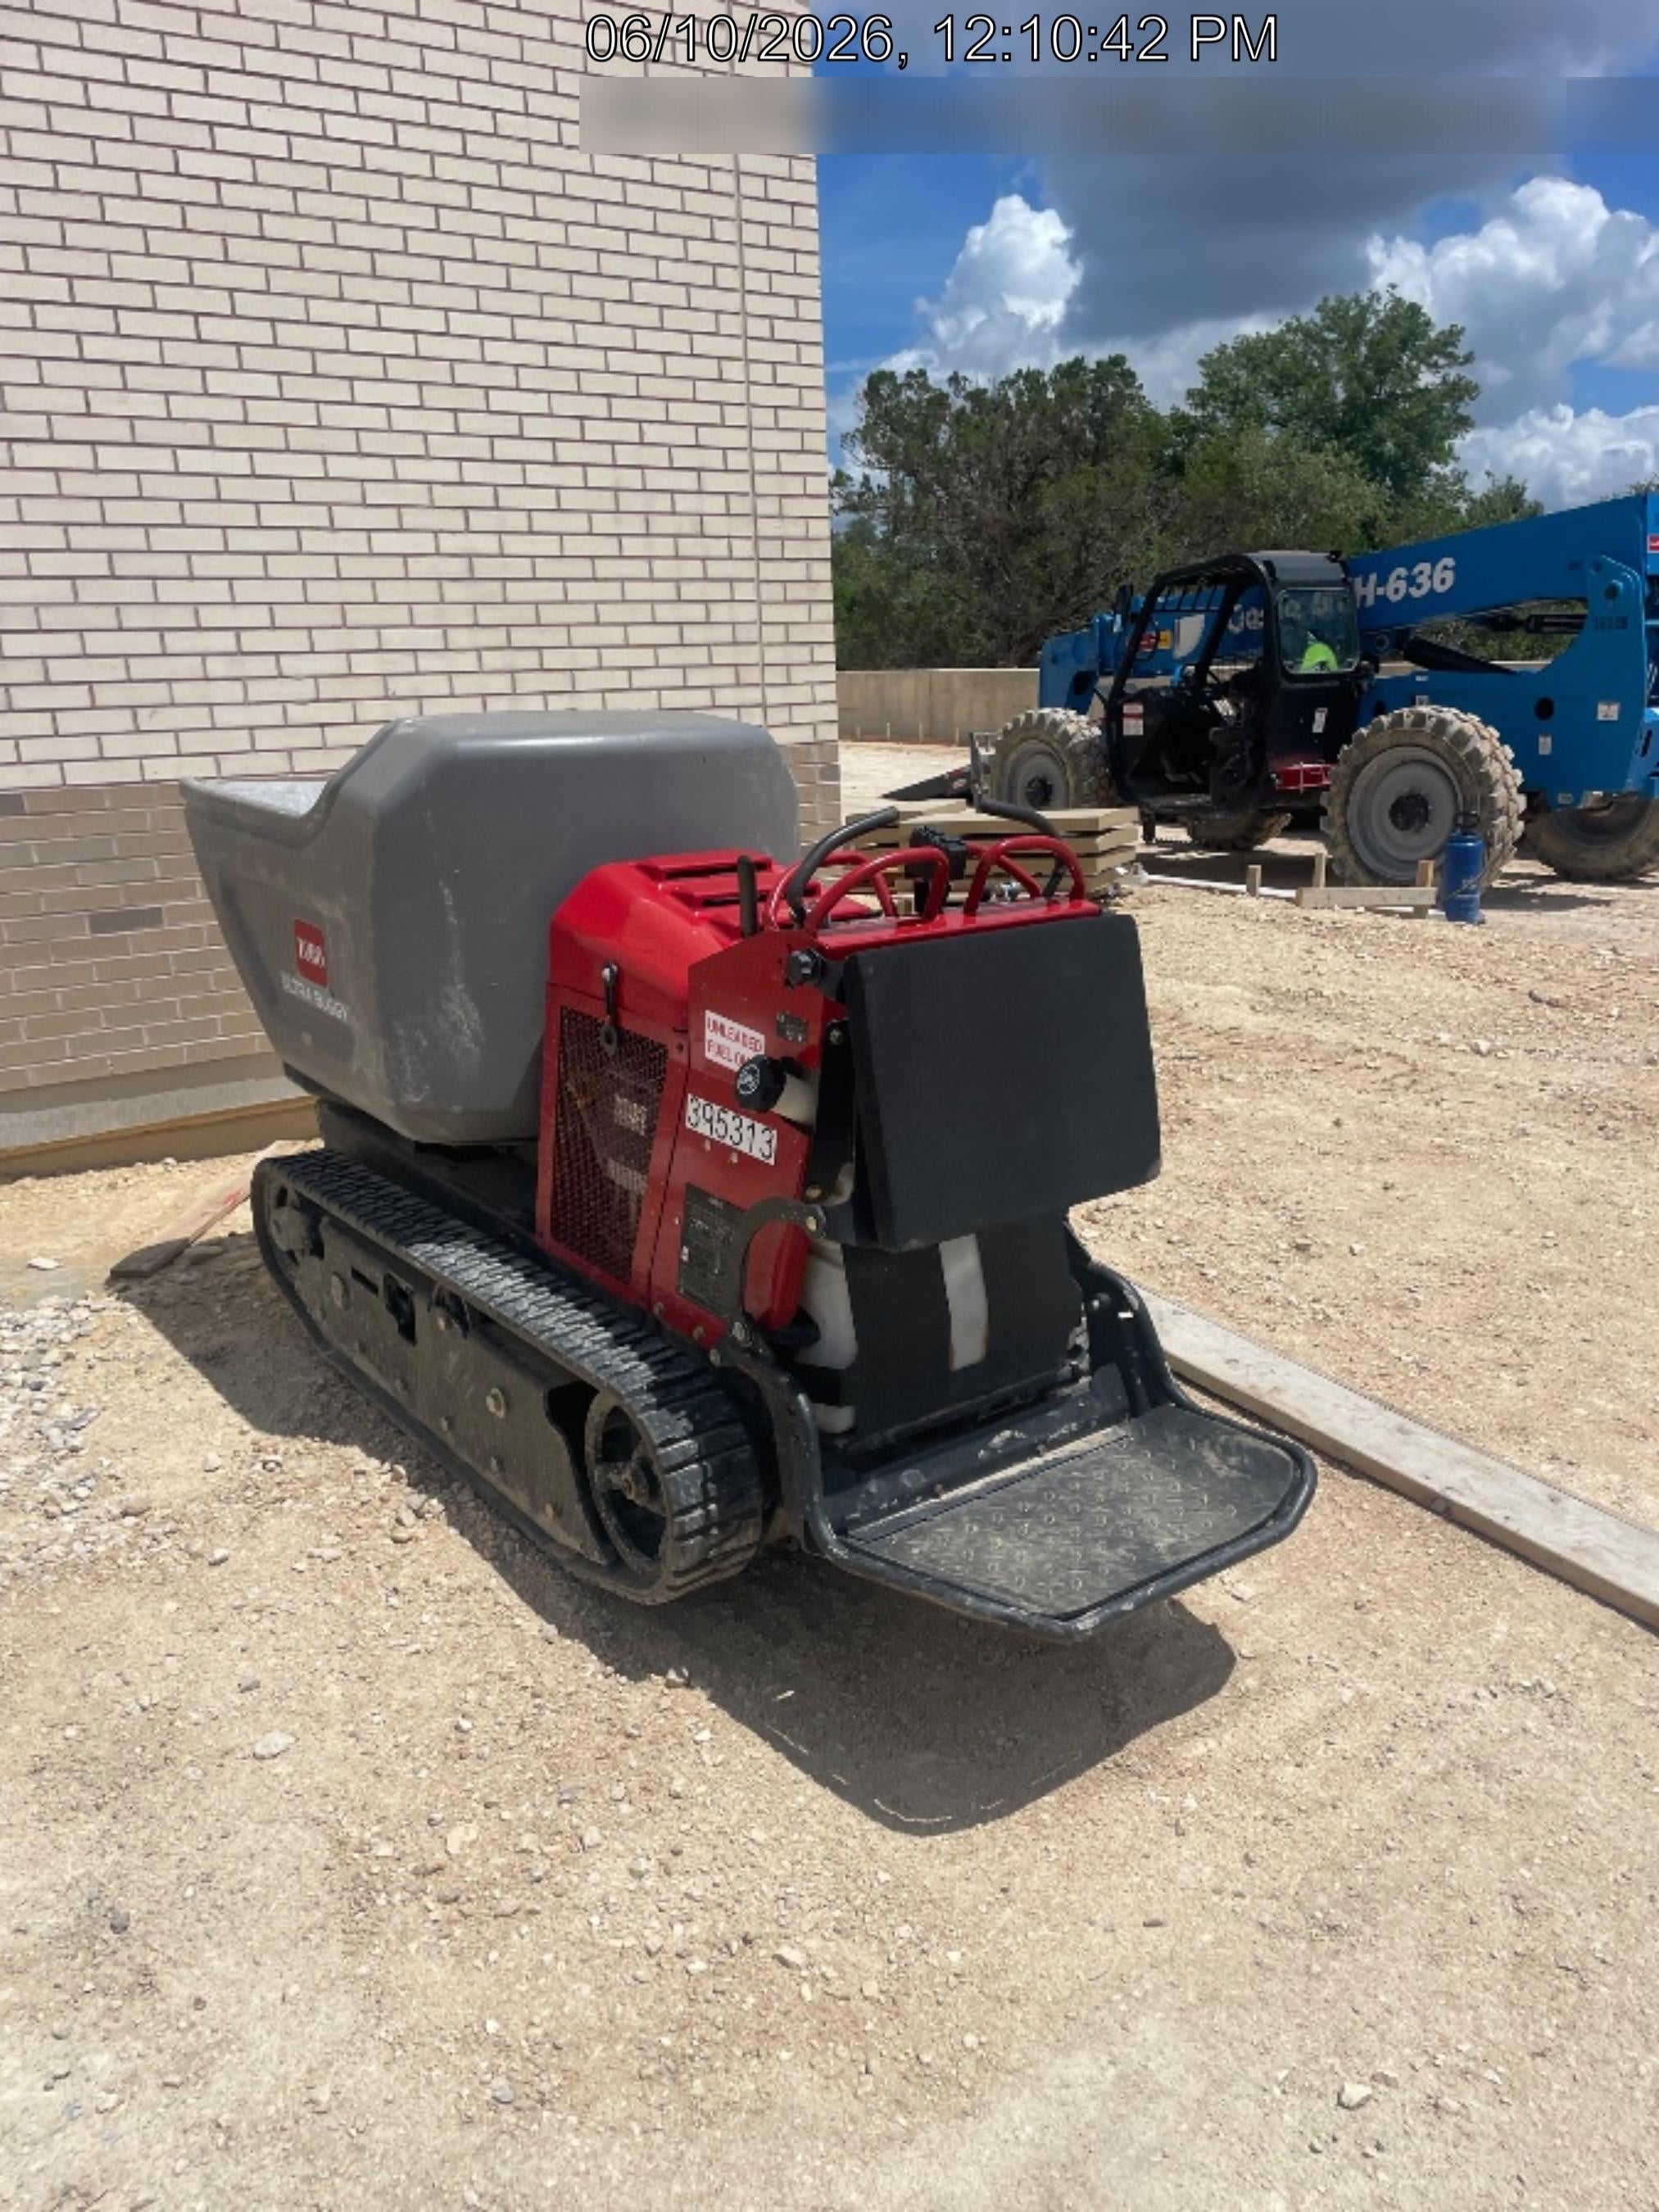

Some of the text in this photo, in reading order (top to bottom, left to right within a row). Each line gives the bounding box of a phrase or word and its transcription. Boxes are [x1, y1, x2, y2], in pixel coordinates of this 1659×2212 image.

[707, 1017, 762, 1052] UNLEADED
[707, 1039, 733, 1062] FUEL
[687, 1095, 774, 1159] 395313
